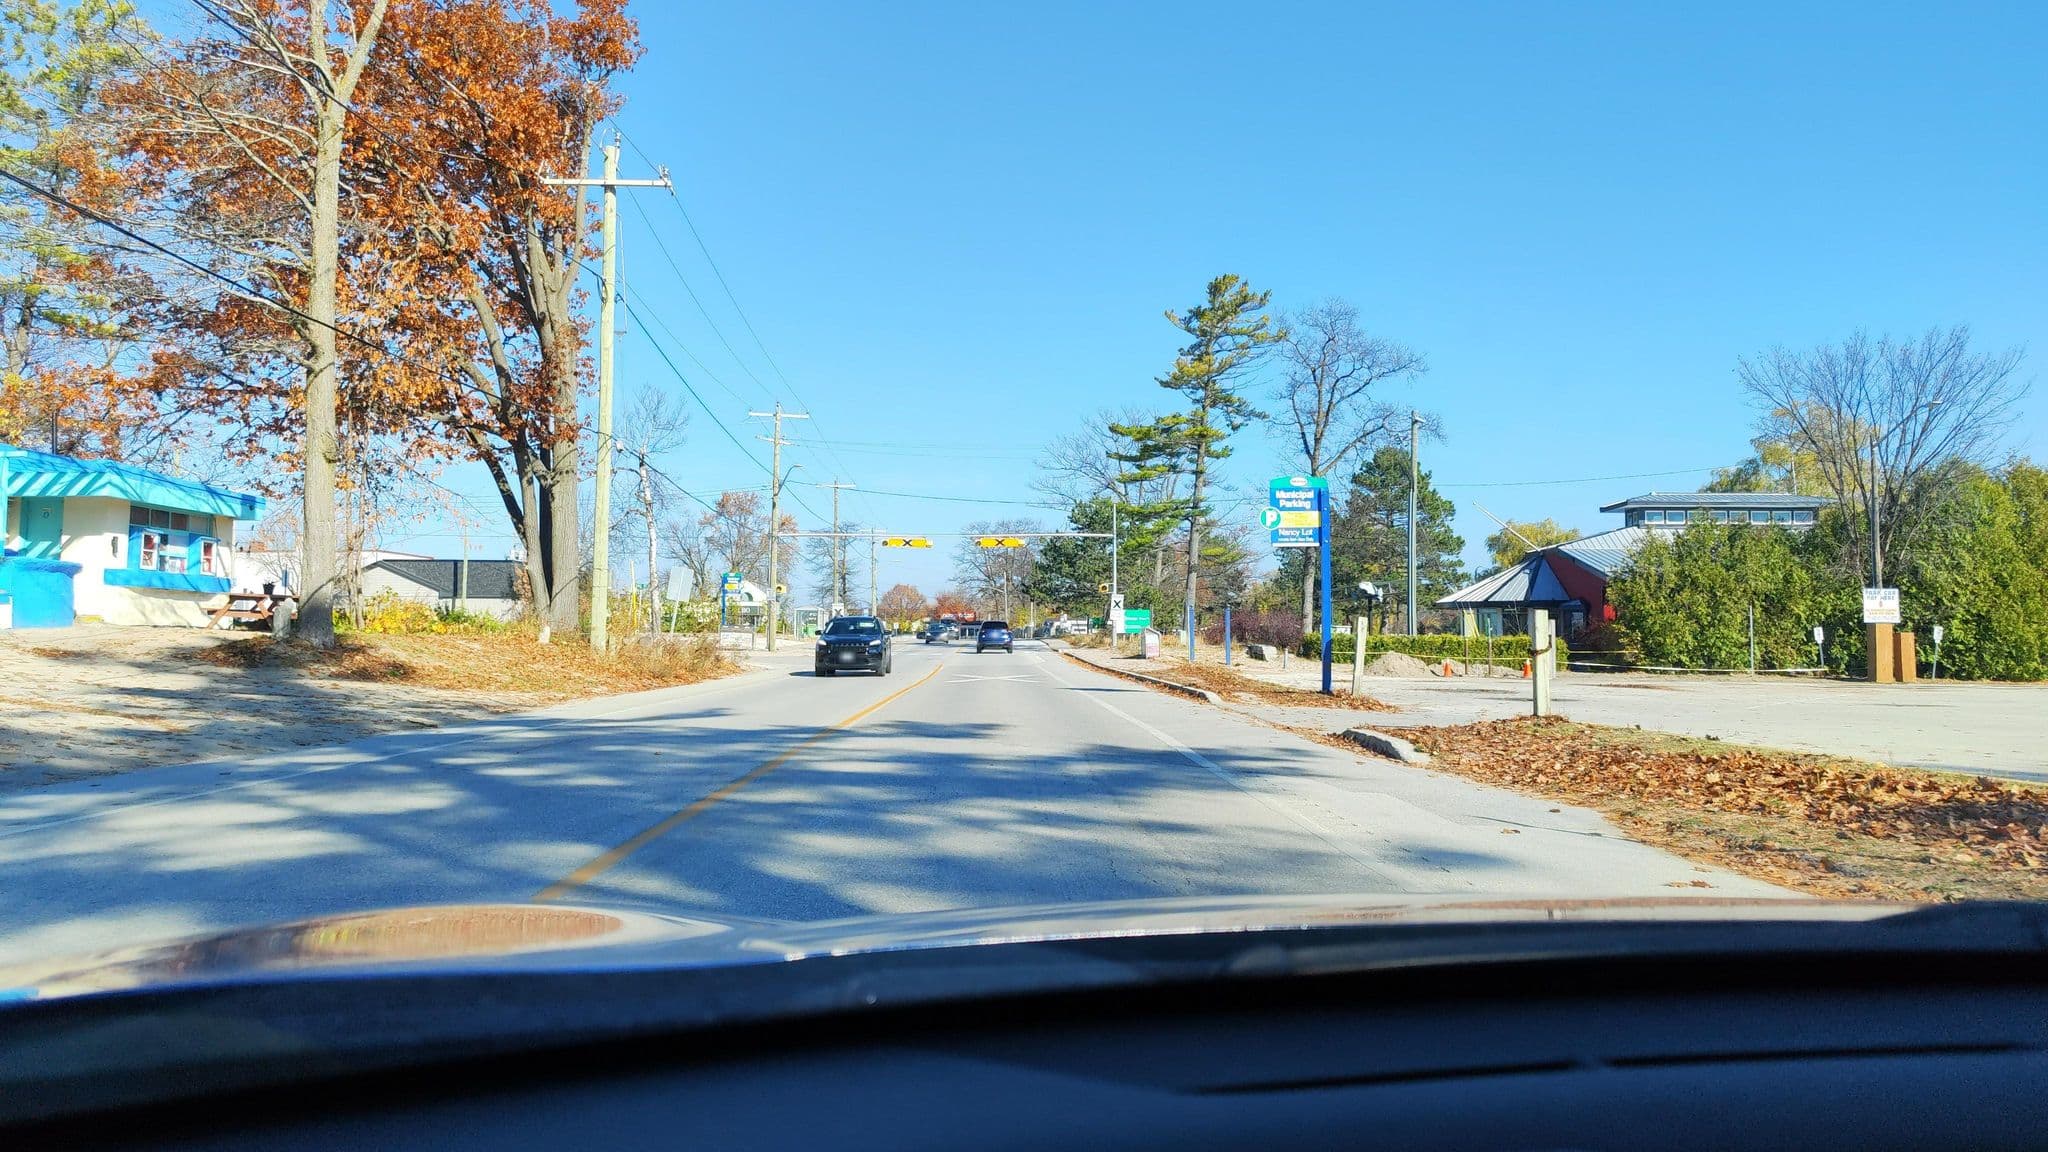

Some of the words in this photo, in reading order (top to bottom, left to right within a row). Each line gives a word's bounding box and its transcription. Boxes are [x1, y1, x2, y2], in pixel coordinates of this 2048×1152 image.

[1276, 490, 1314, 499] Municipal
[1279, 499, 1311, 509] Parking
[1266, 511, 1277, 526] P
[1279, 528, 1300, 538] Nancy
[1301, 528, 1313, 536] Lot
